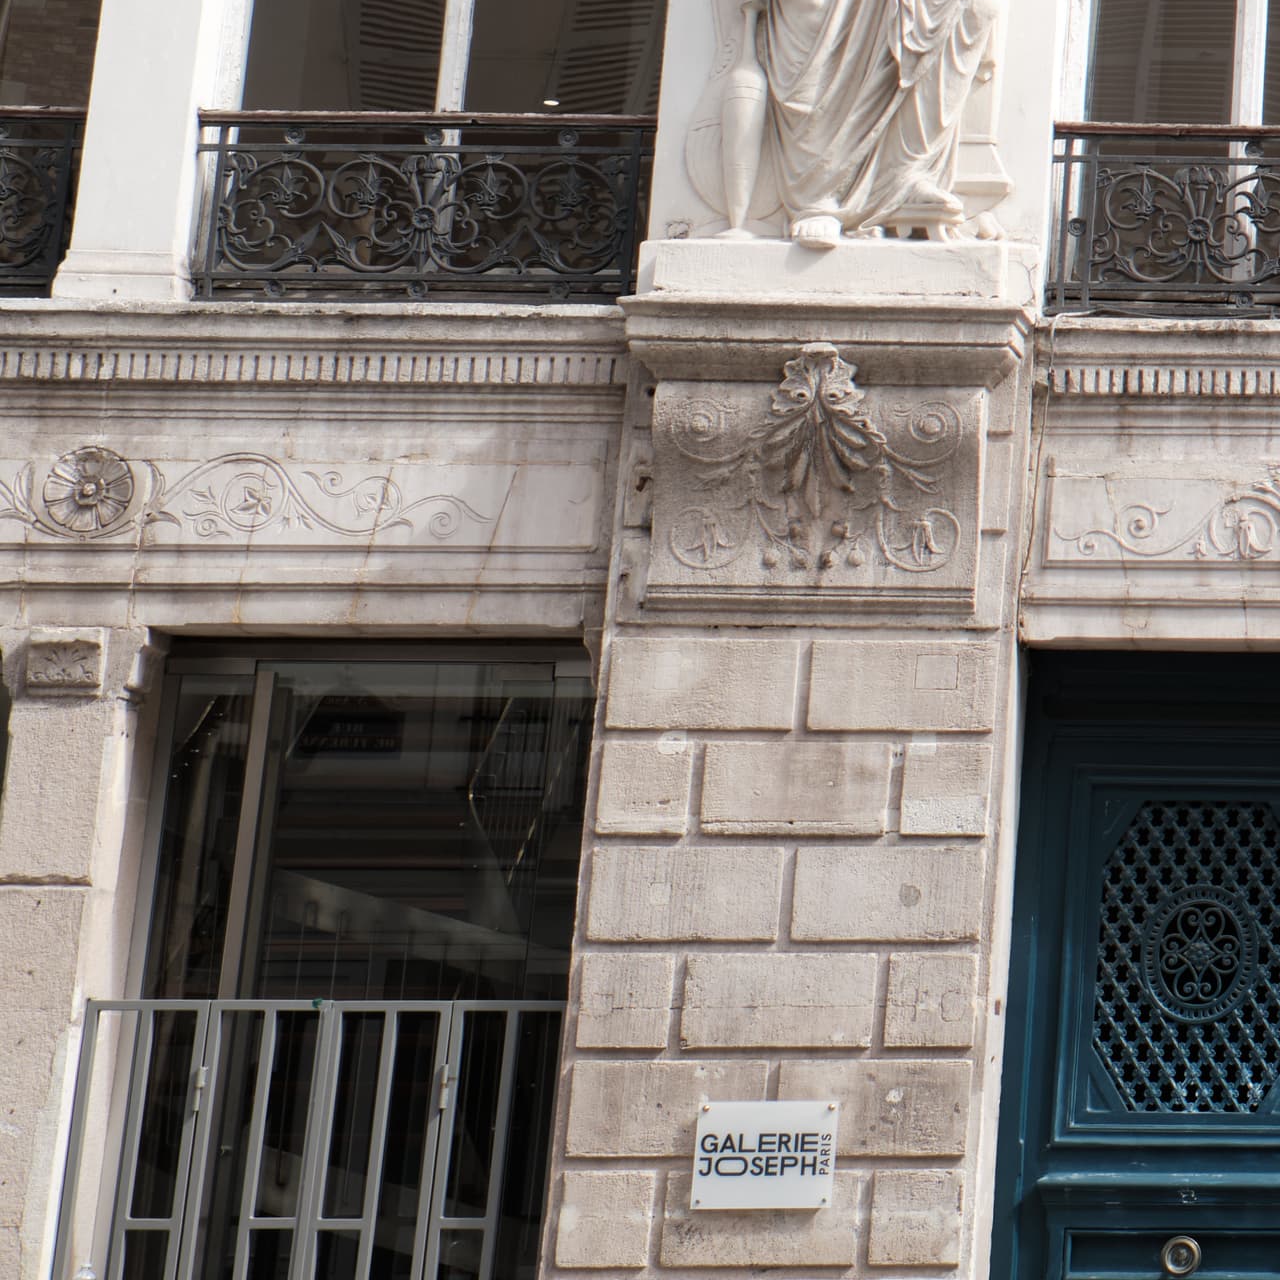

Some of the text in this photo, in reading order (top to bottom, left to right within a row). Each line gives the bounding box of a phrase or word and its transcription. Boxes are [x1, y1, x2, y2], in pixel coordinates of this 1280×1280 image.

[700, 1132, 819, 1154] GALERIE
[819, 1133, 832, 1176] PARIS
[698, 1156, 818, 1177] JOSEPH
